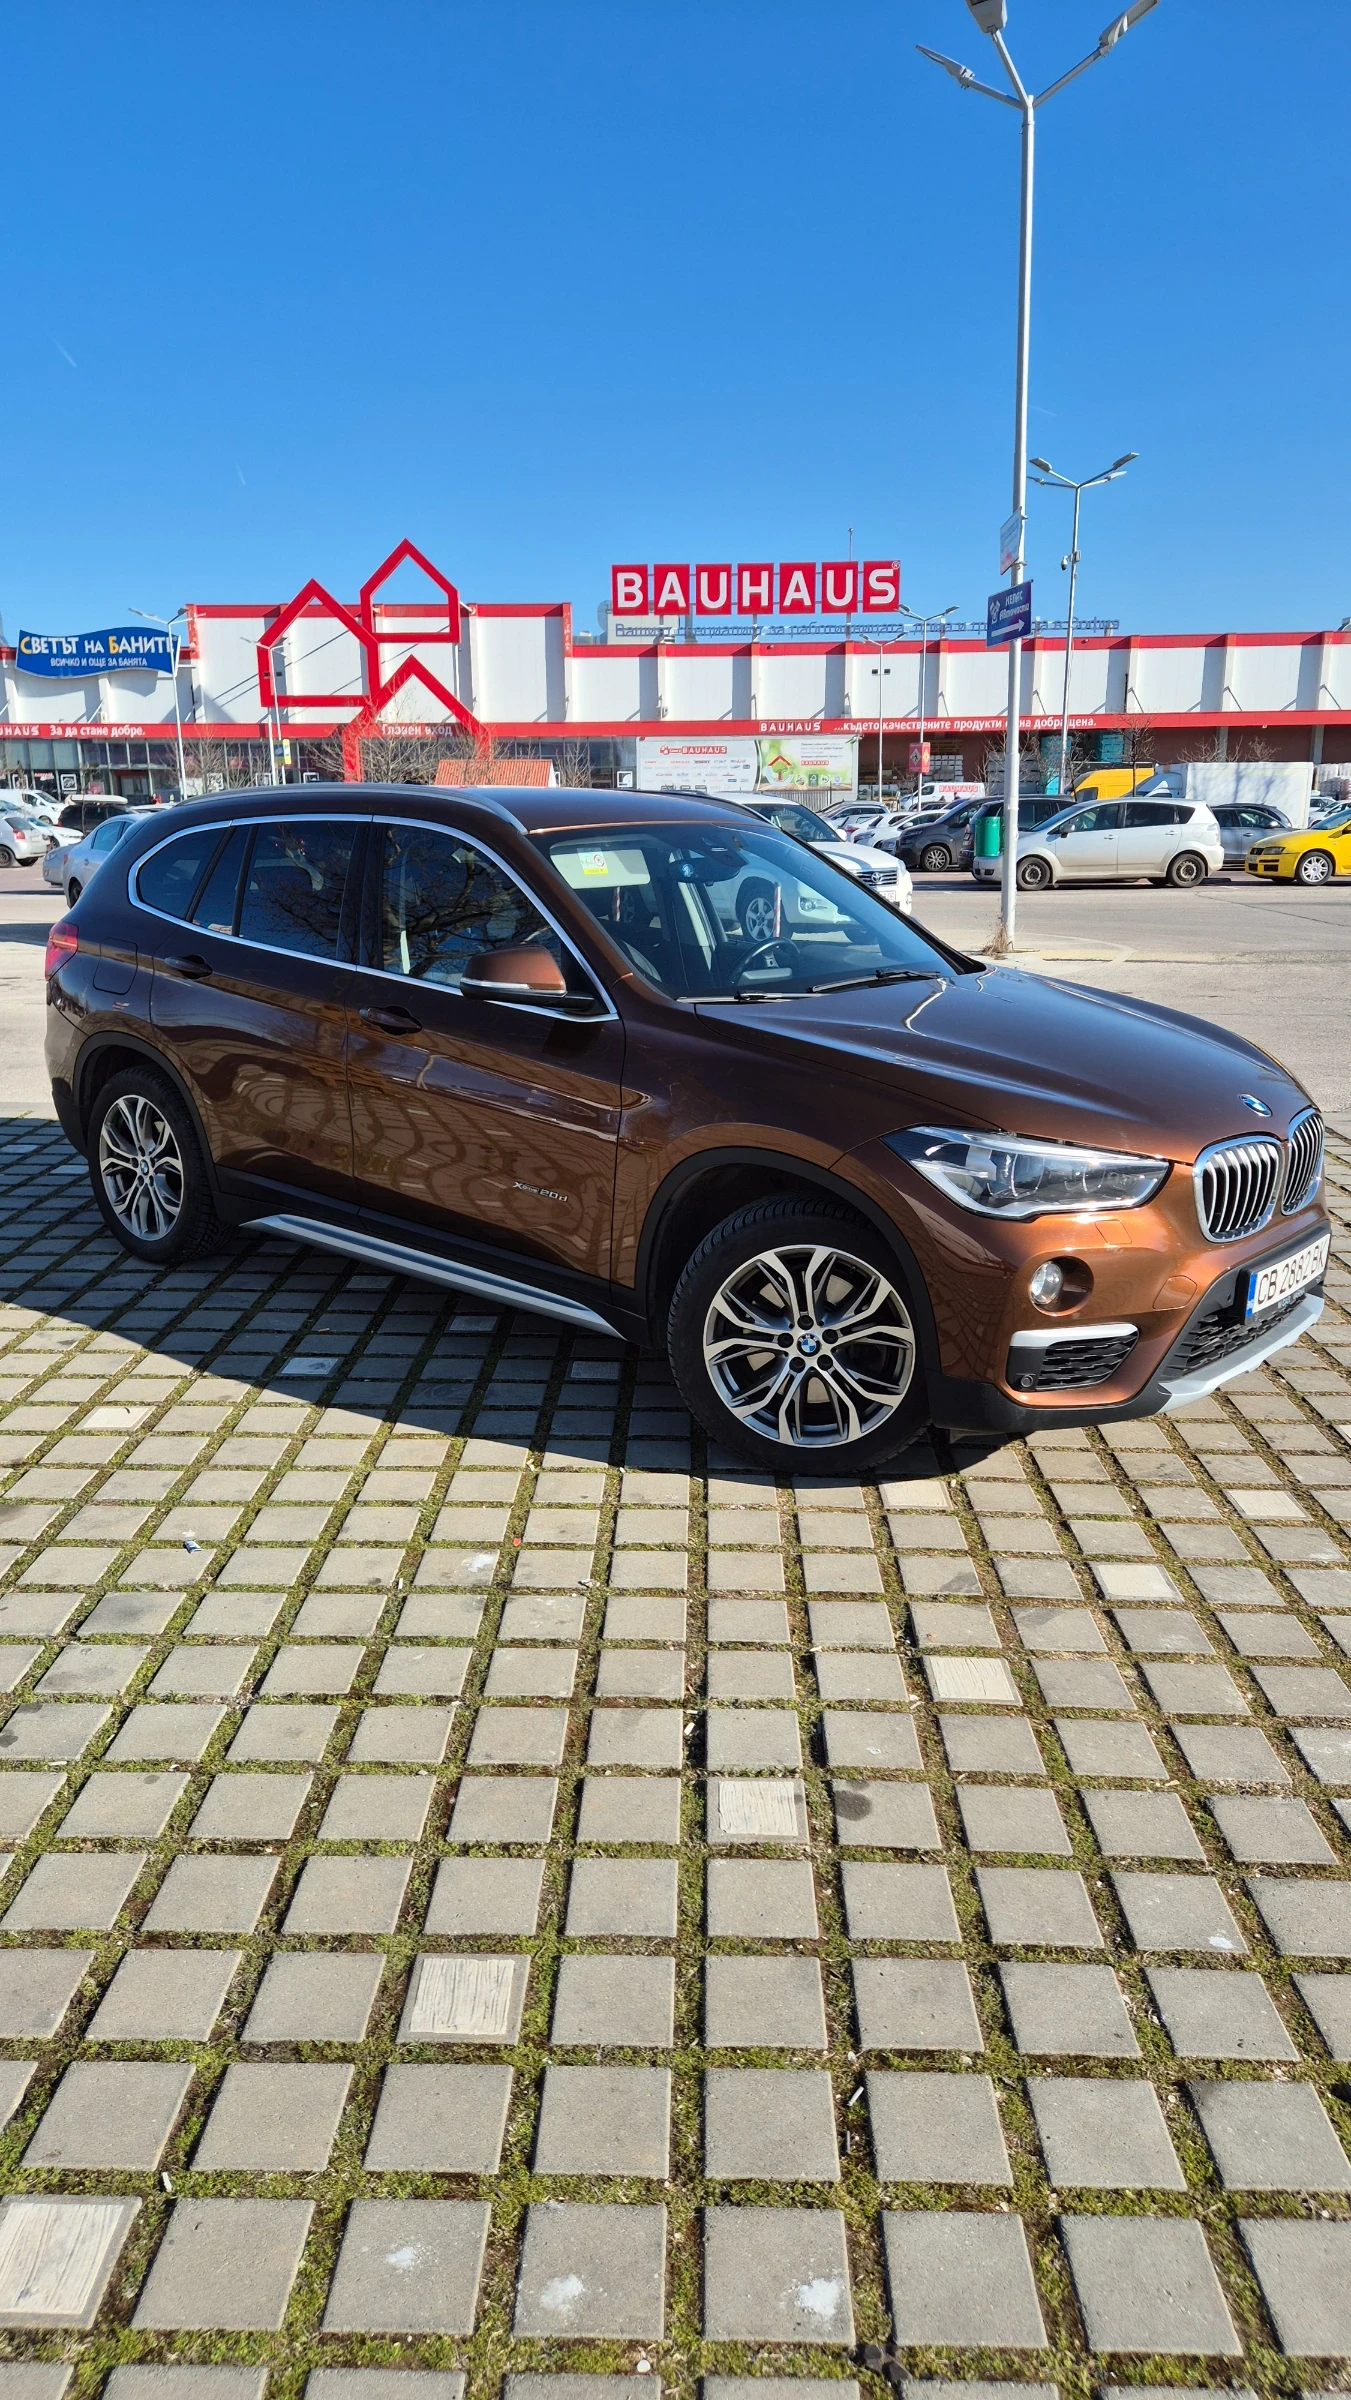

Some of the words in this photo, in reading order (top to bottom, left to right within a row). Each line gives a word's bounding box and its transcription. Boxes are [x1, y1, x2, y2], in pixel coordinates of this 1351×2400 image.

[616, 568, 896, 609] BAUHAUS
[20, 636, 79, 655] СВЕТЪТ
[85, 640, 105, 654] НА
[50, 657, 80, 667] ВСИЧКО
[88, 657, 107, 668] ОЩЕ
[108, 657, 118, 667] ЗА
[118, 657, 148, 667] БАНЯТА
[50, 725, 63, 736] За
[64, 726, 78, 737] да
[80, 725, 109, 736] стане
[381, 723, 422, 736] Главен
[760, 721, 822, 732] BAUHAUS
[953, 718, 1002, 732] продукти
[682, 745, 728, 755] BAUHAUS
